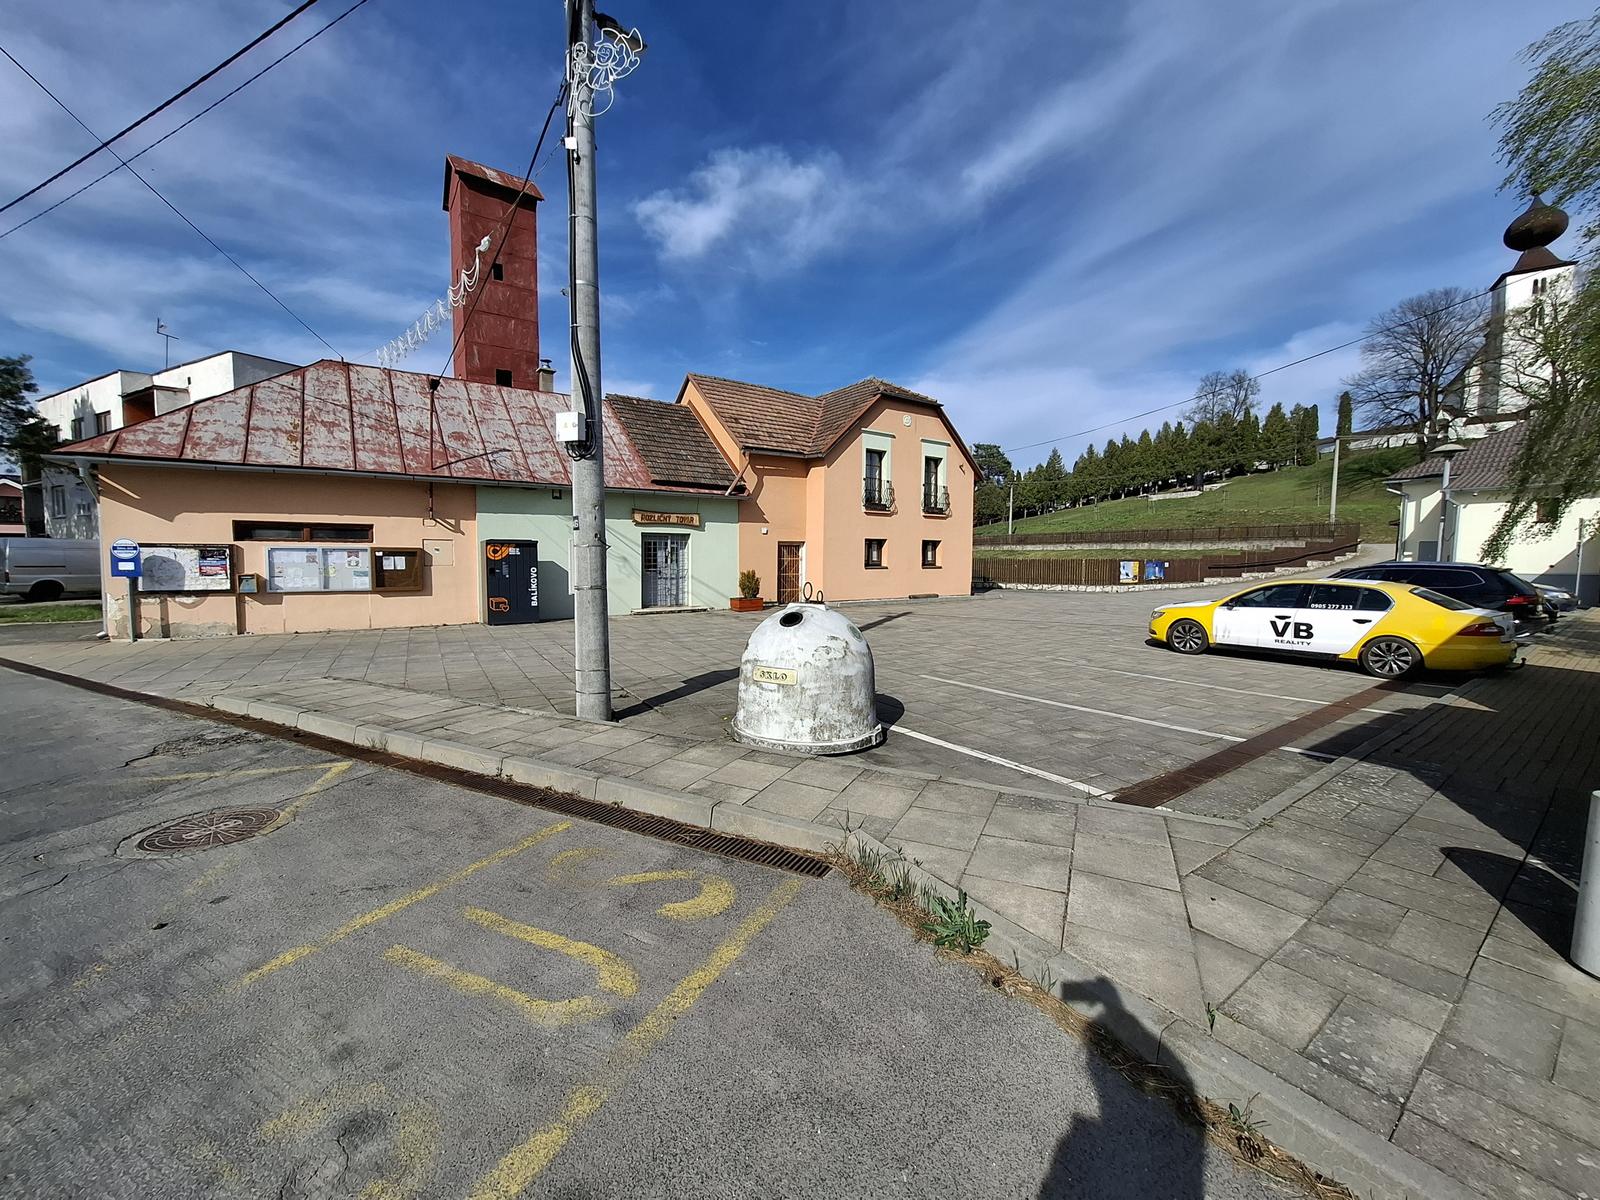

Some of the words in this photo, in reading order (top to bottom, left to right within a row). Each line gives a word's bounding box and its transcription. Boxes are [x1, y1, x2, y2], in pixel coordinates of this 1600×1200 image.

[675, 515, 695, 524] TOVAR
[528, 566, 538, 607] BALÍKOVO
[1269, 620, 1314, 639] VB
[759, 670, 788, 681] SKLO
